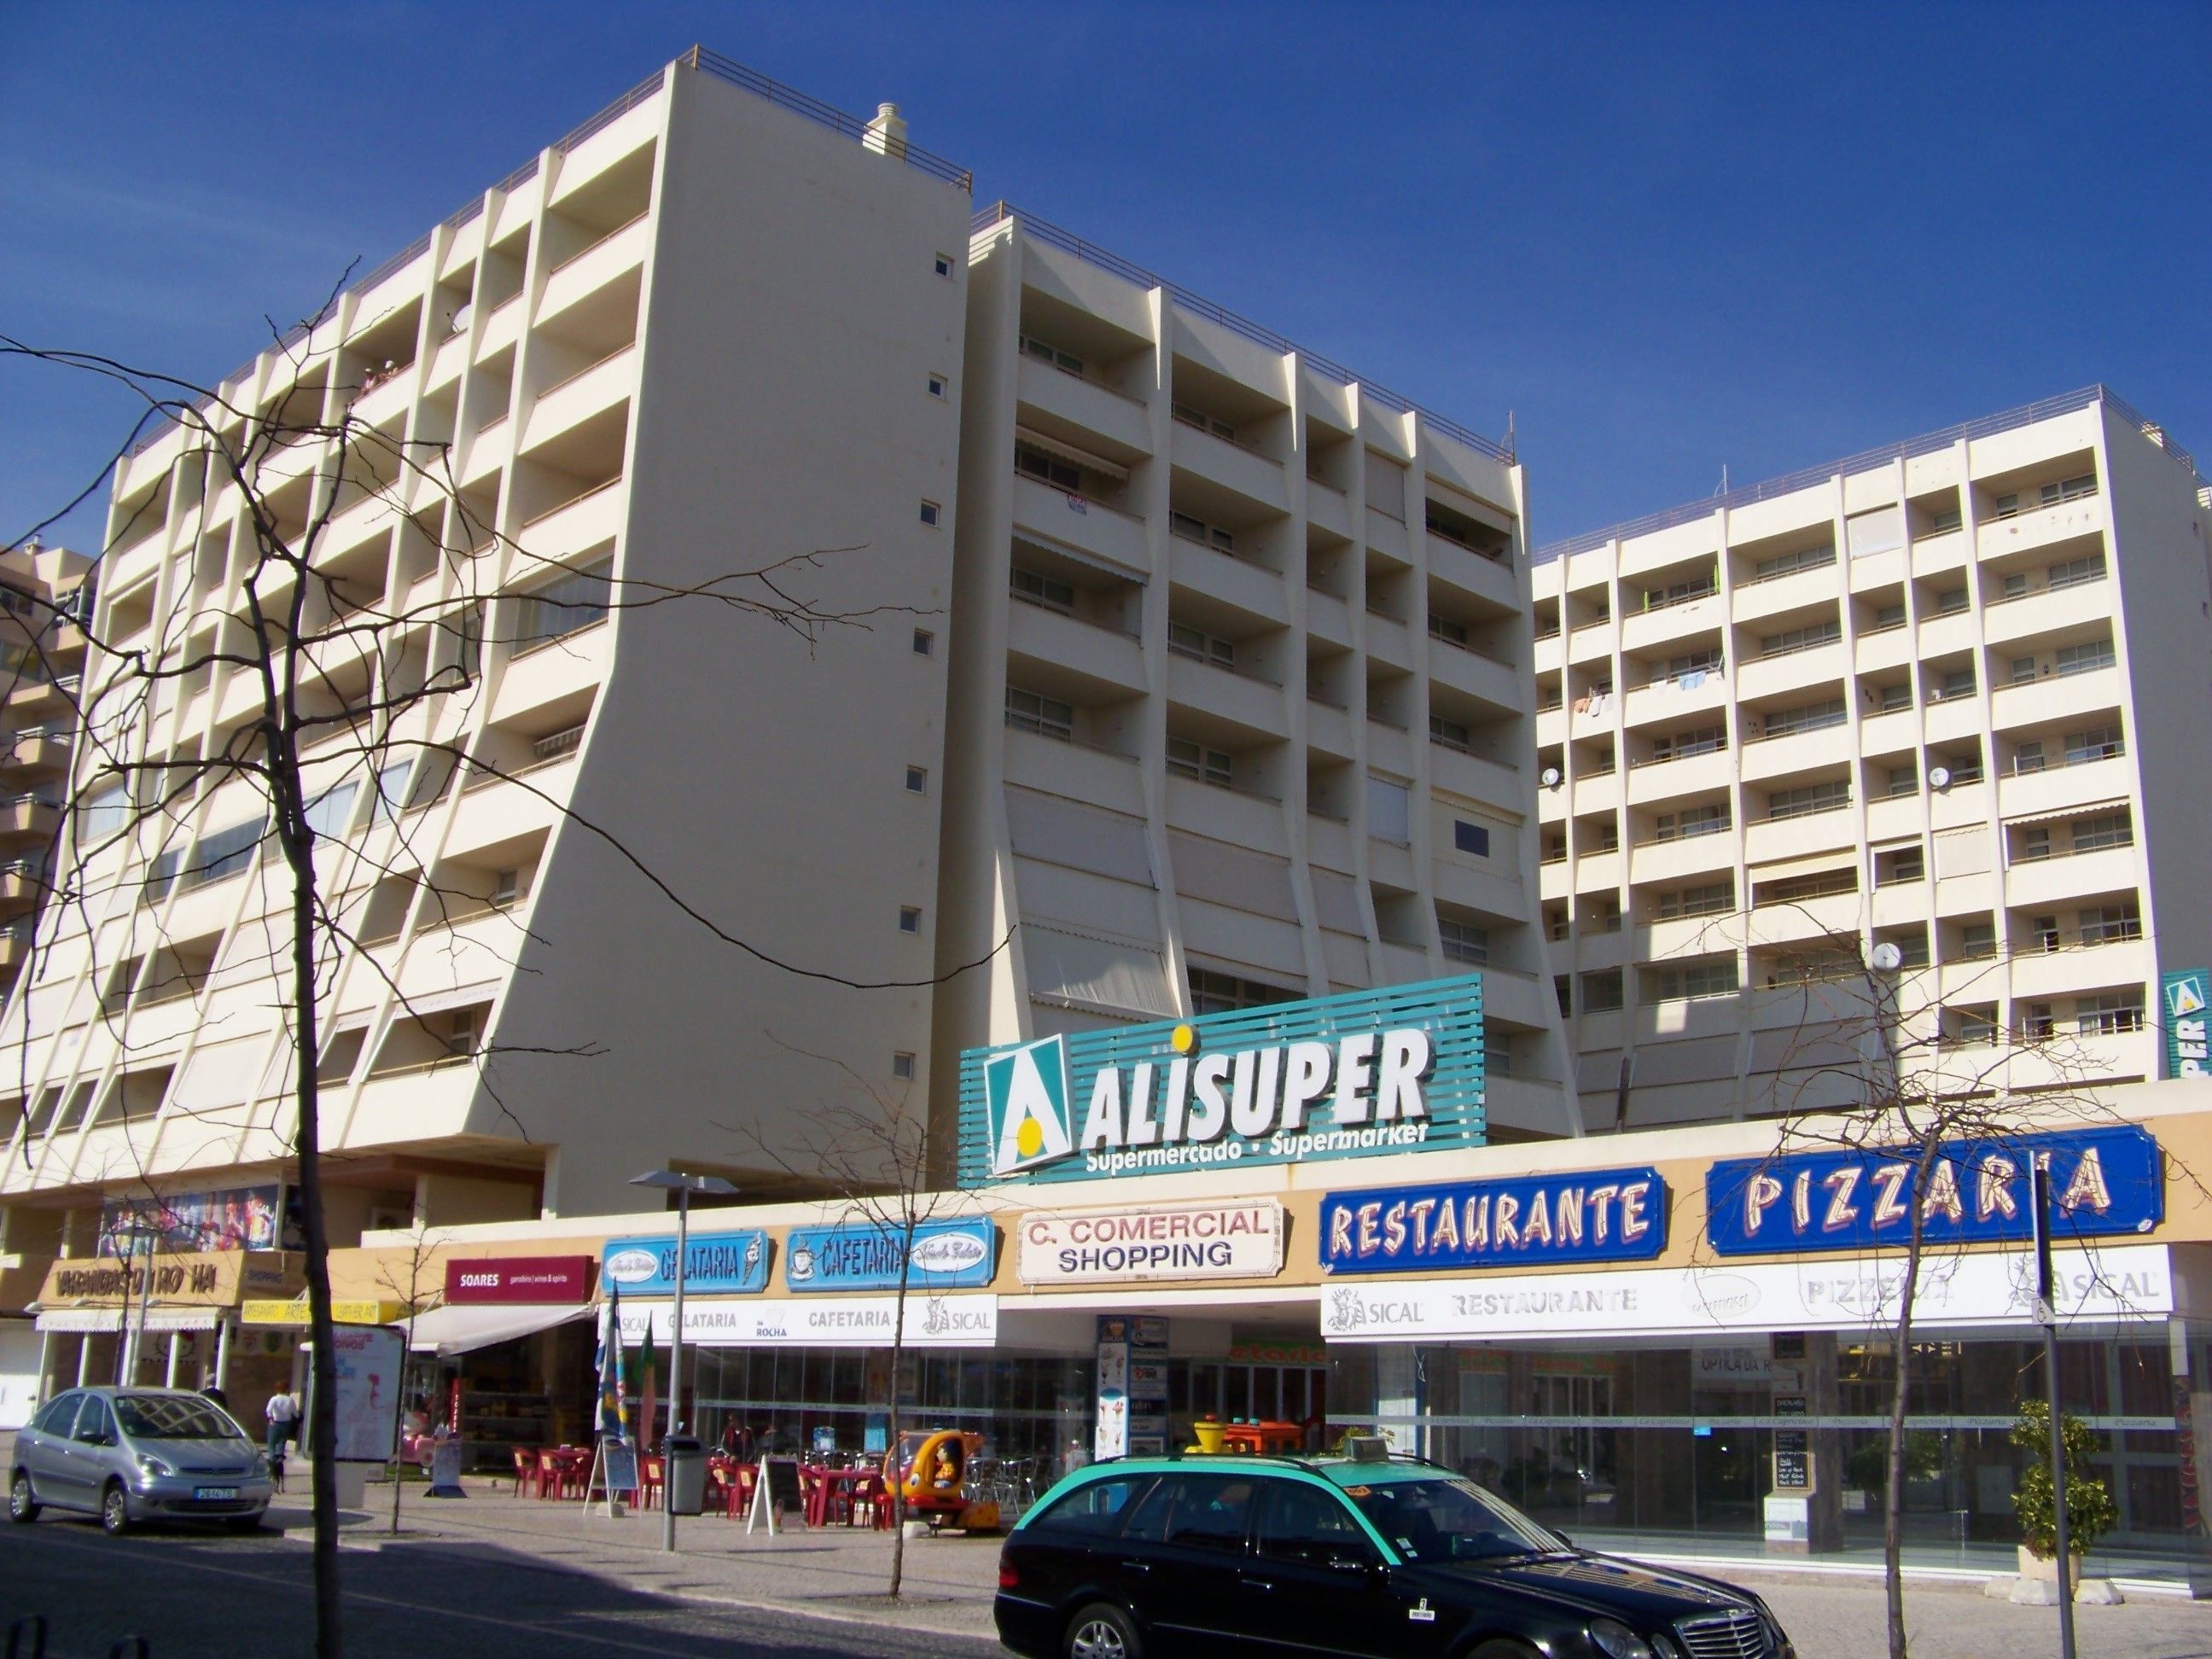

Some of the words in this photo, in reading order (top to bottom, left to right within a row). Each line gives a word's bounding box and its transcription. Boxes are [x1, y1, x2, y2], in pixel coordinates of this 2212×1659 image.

[1080, 1025, 1434, 1151] ALISUPER
[1086, 1138, 1243, 1176] Supermercado
[1270, 1123, 1429, 1161] Supermarket
[1747, 1147, 2111, 1234] PIZZARA
[1027, 1221, 1058, 1246] C.
[1070, 1209, 1270, 1243] COMERCIAL
[1331, 1183, 1650, 1254] RESTAURANTE
[1059, 1241, 1232, 1273] SHOPPING
[460, 1274, 499, 1287] SOARES
[2075, 1272, 2159, 1300] SICAL
[668, 1313, 736, 1328] GLATARIA
[808, 1311, 890, 1327] CAFETARIA
[952, 1313, 991, 1330] SICAL
[1370, 1302, 1424, 1324] SICAL
[1452, 1289, 1638, 1317] RESTAURANTE
[756, 1328, 787, 1336] ROCHA
